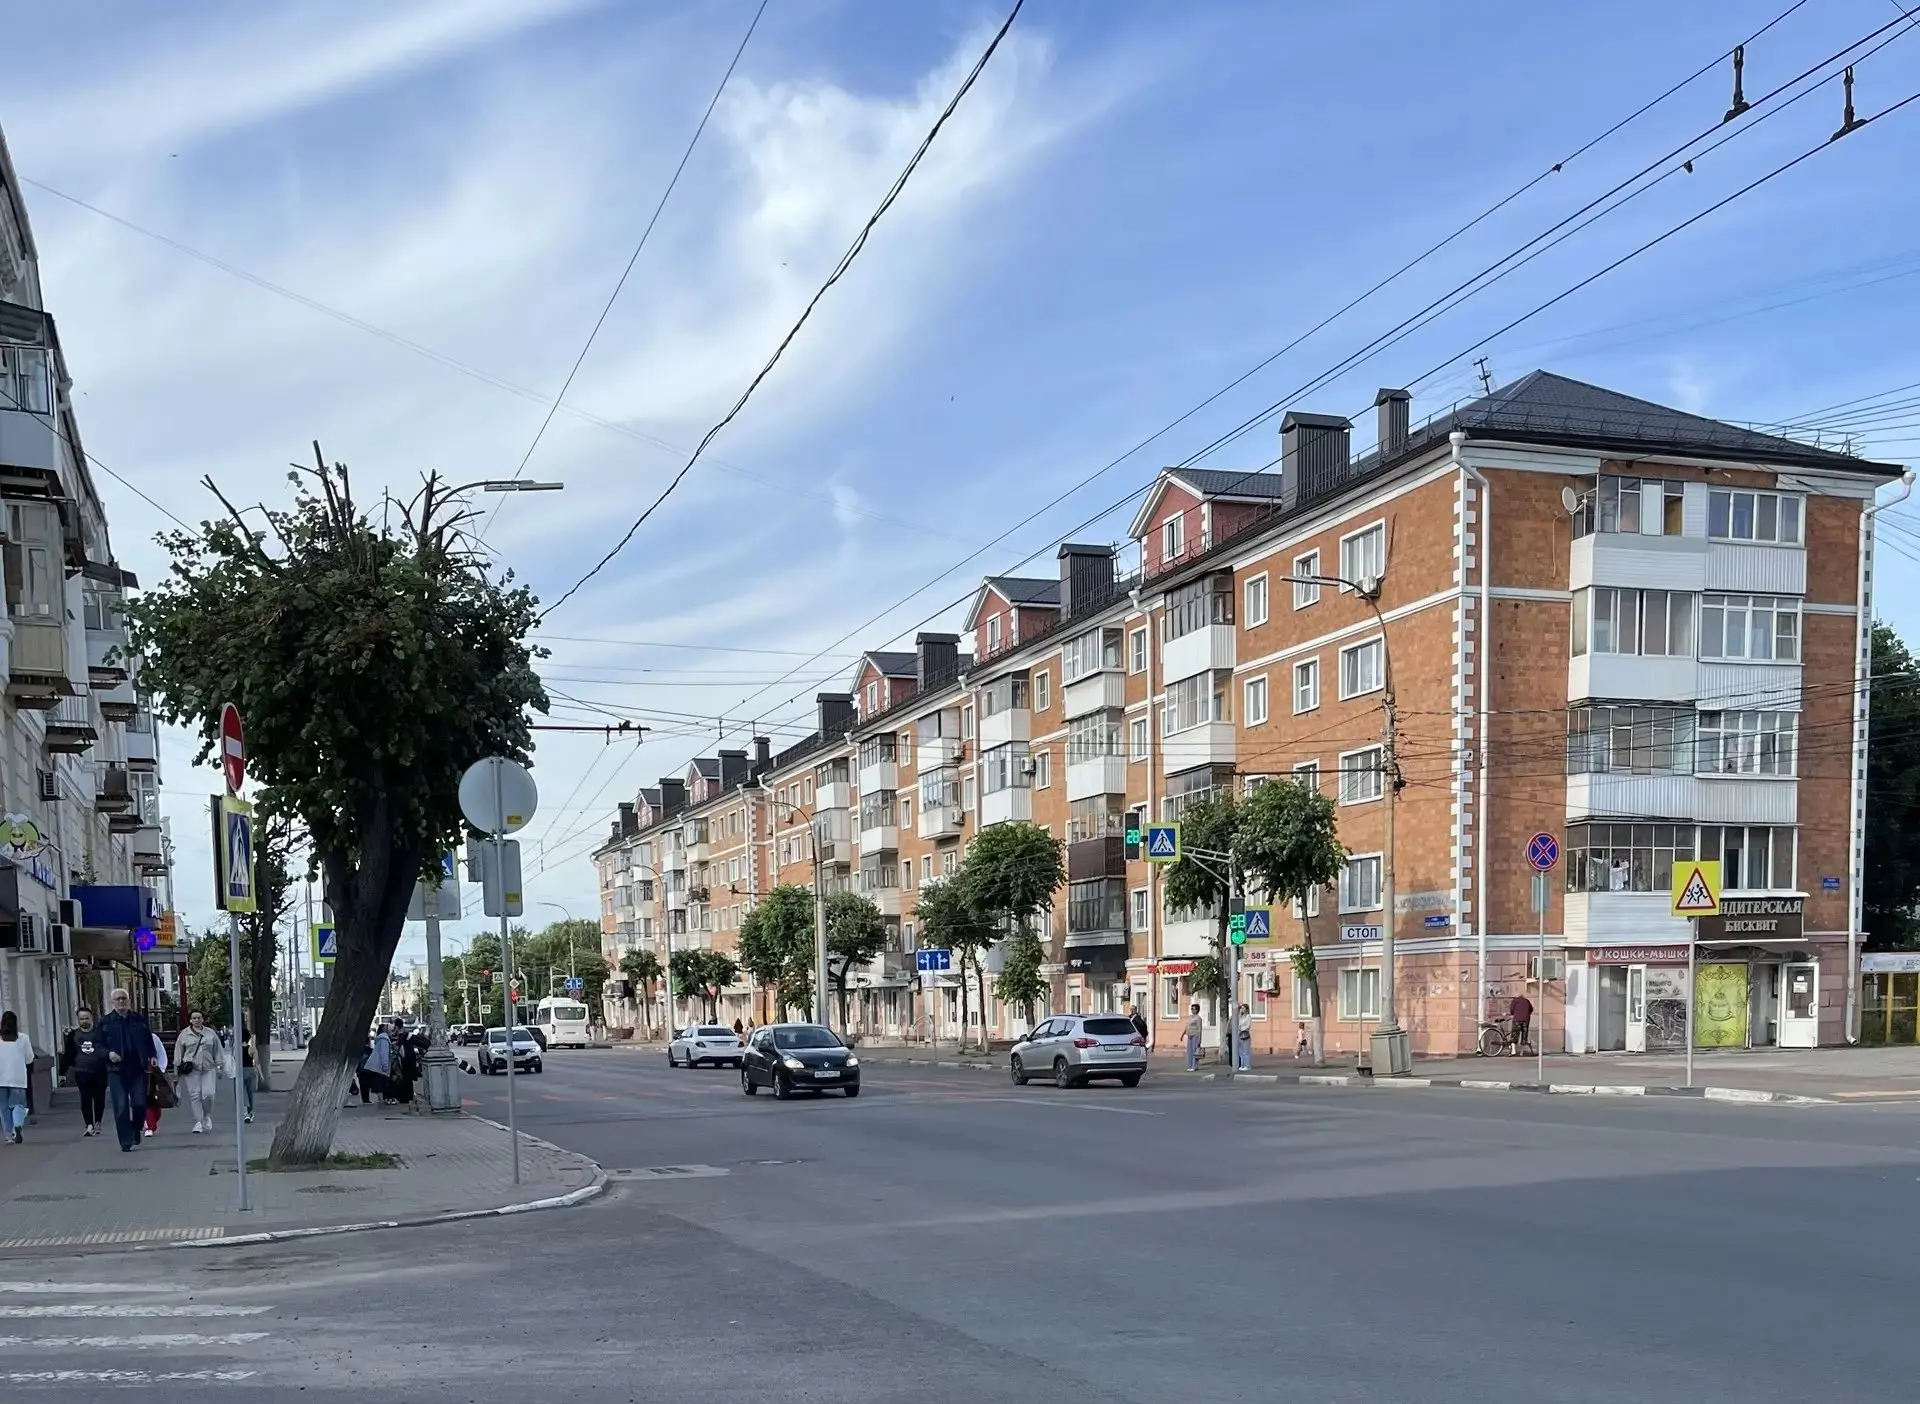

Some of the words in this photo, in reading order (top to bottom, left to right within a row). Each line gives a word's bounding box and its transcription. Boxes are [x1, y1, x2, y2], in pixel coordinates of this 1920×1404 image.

[1127, 830, 1139, 844] 28
[1720, 900, 1802, 917] НДИТЕРСКАЯ
[1231, 914, 1246, 929] 28
[1724, 920, 1778, 932] БИСКВИТ
[1347, 927, 1378, 938] СТОП
[1251, 952, 1266, 960] 585
